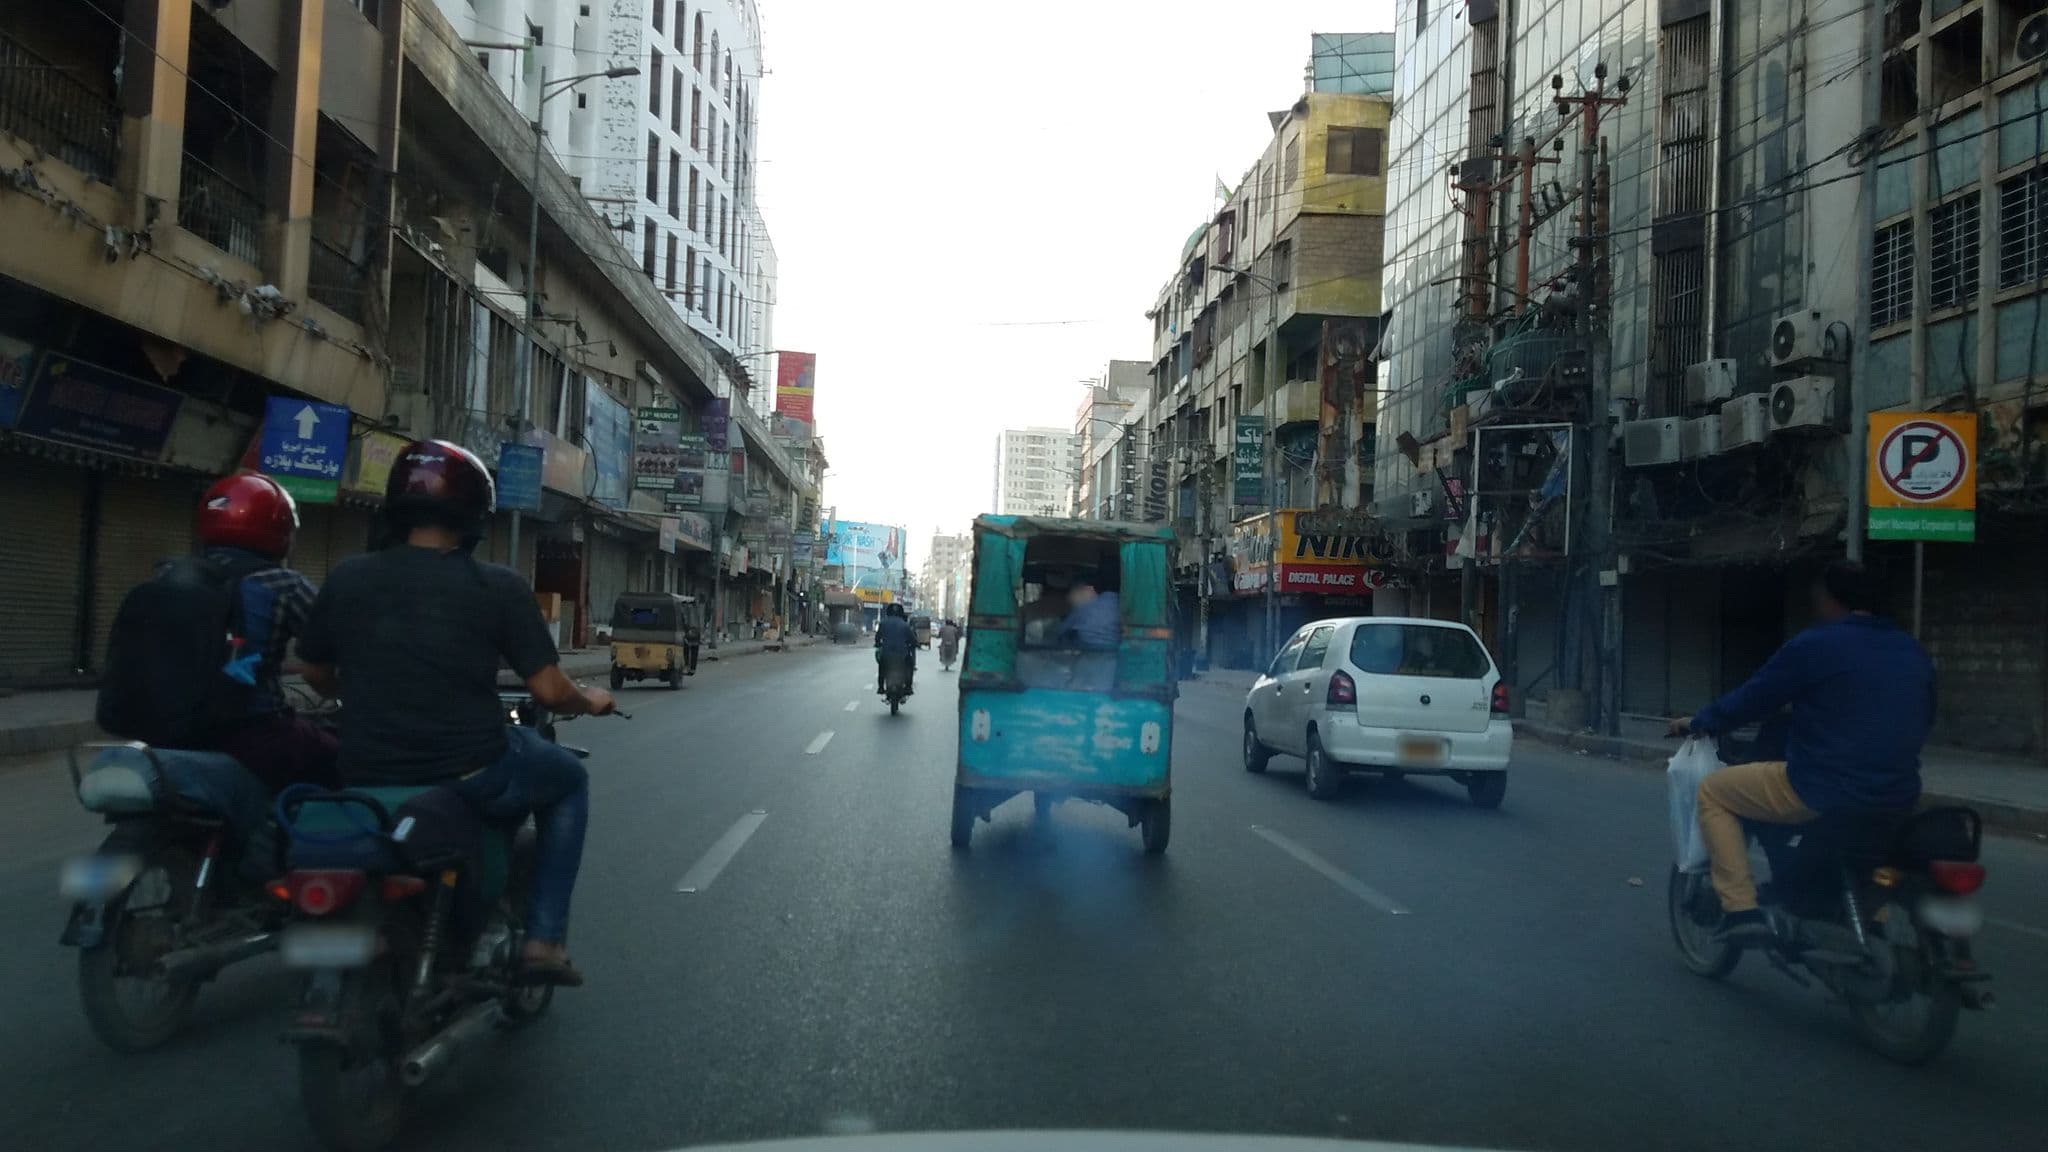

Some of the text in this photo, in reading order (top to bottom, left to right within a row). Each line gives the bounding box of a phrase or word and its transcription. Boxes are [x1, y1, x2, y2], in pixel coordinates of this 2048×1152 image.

[653, 412, 679, 420] MARCH
[1237, 428, 1262, 450] پاک
[294, 455, 339, 477] پارکنگ
[1144, 463, 1168, 522] Nikon
[799, 497, 815, 530] kon
[1288, 572, 1320, 585] DIGITAL
[1322, 574, 1356, 586] PALACE
